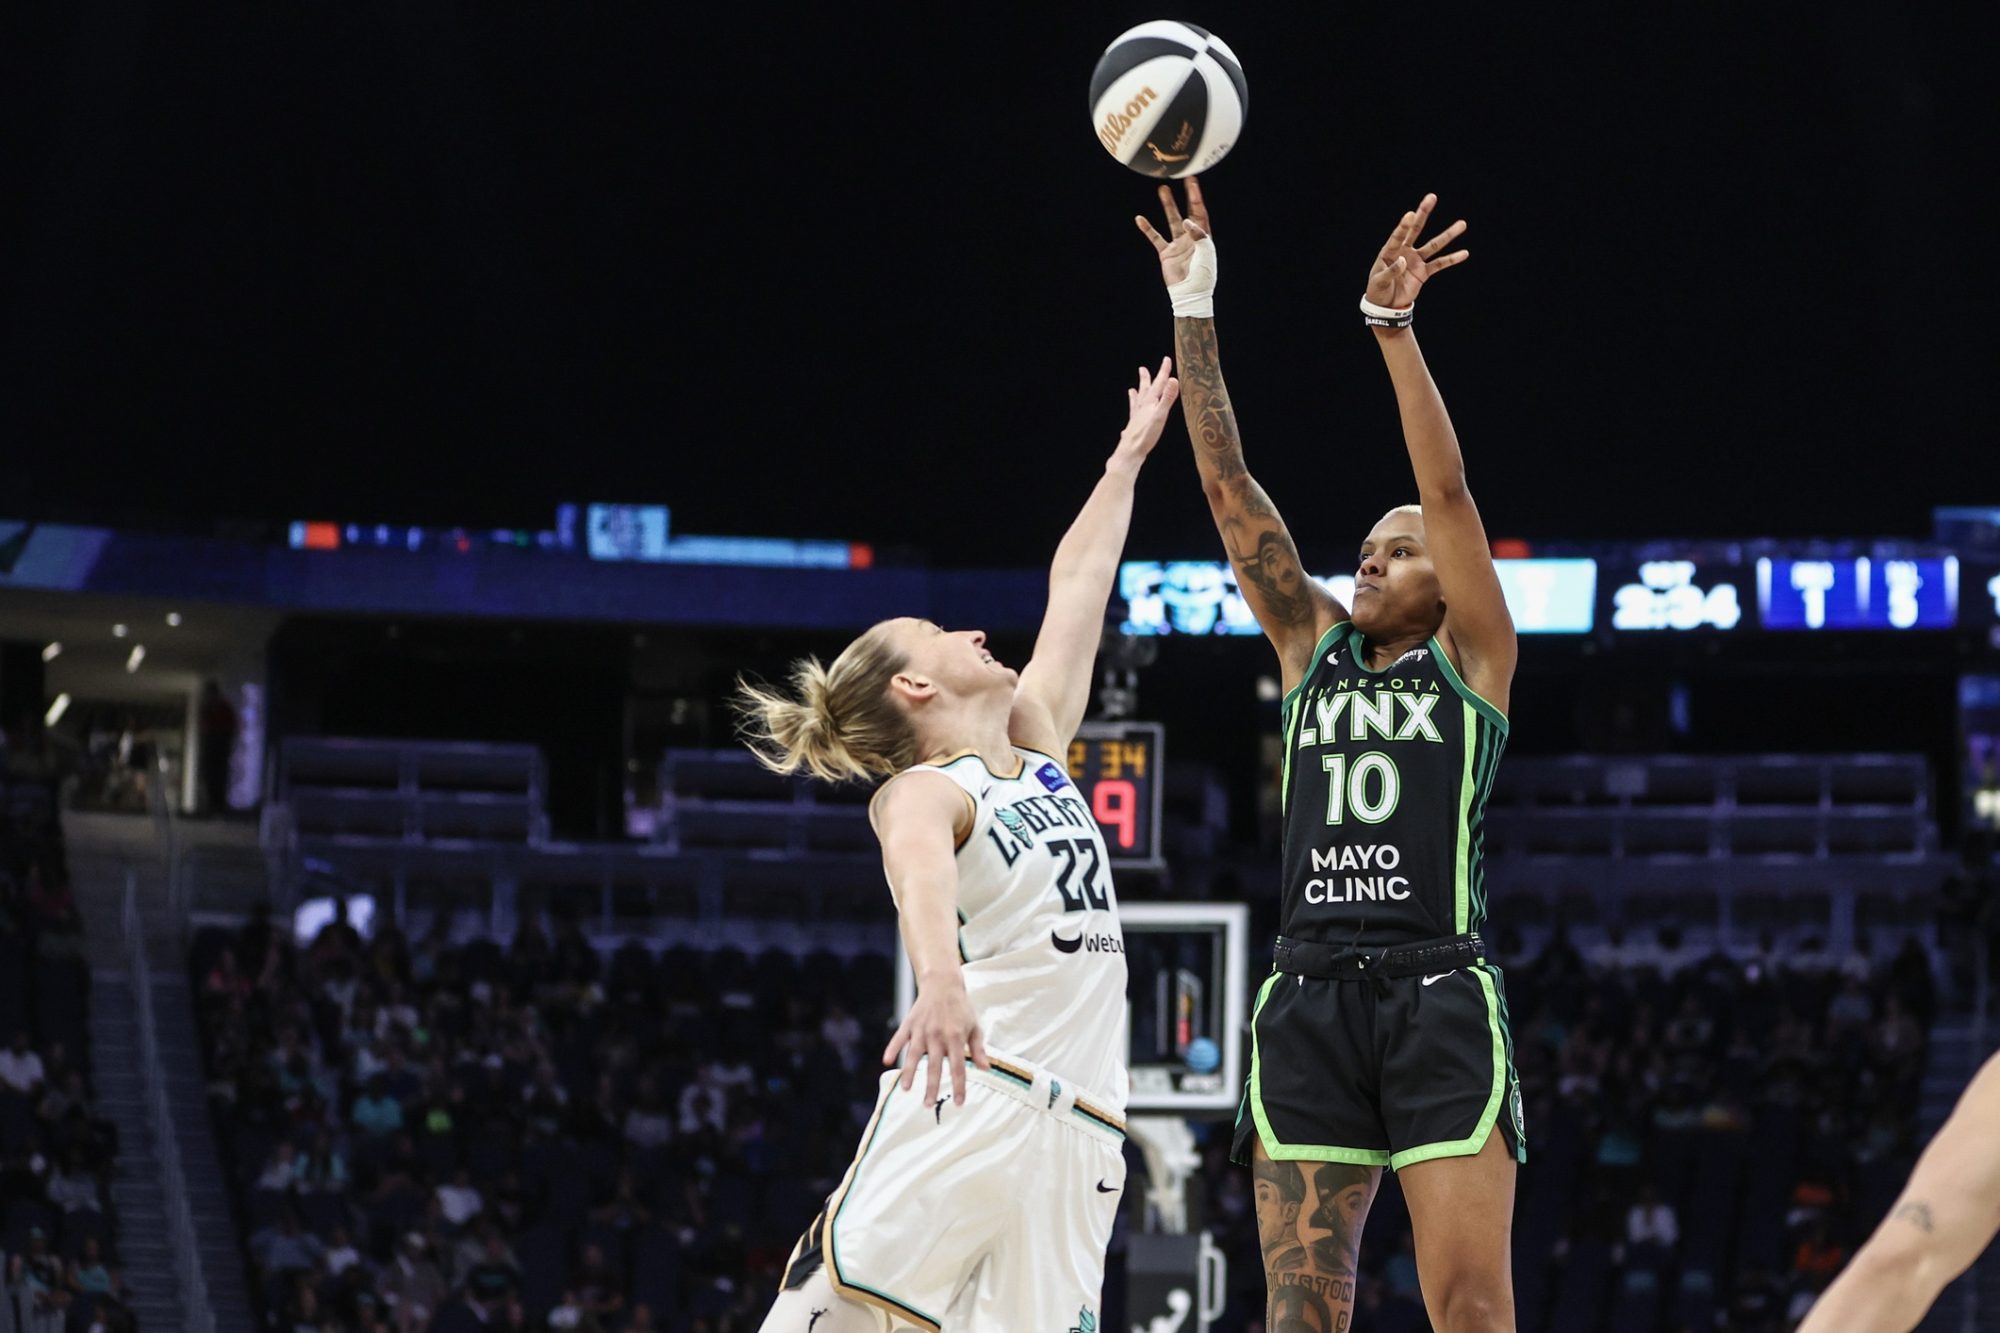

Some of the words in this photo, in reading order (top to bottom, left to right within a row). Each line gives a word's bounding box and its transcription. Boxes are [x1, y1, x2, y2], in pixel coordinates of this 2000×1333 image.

[1298, 690, 1444, 750] LYNX
[1093, 779, 1137, 849] 9
[1322, 751, 1400, 826] 10
[1045, 838, 1110, 912] 22
[1304, 876, 1411, 905] CLINIC
[1311, 844, 1400, 873] MAYO
